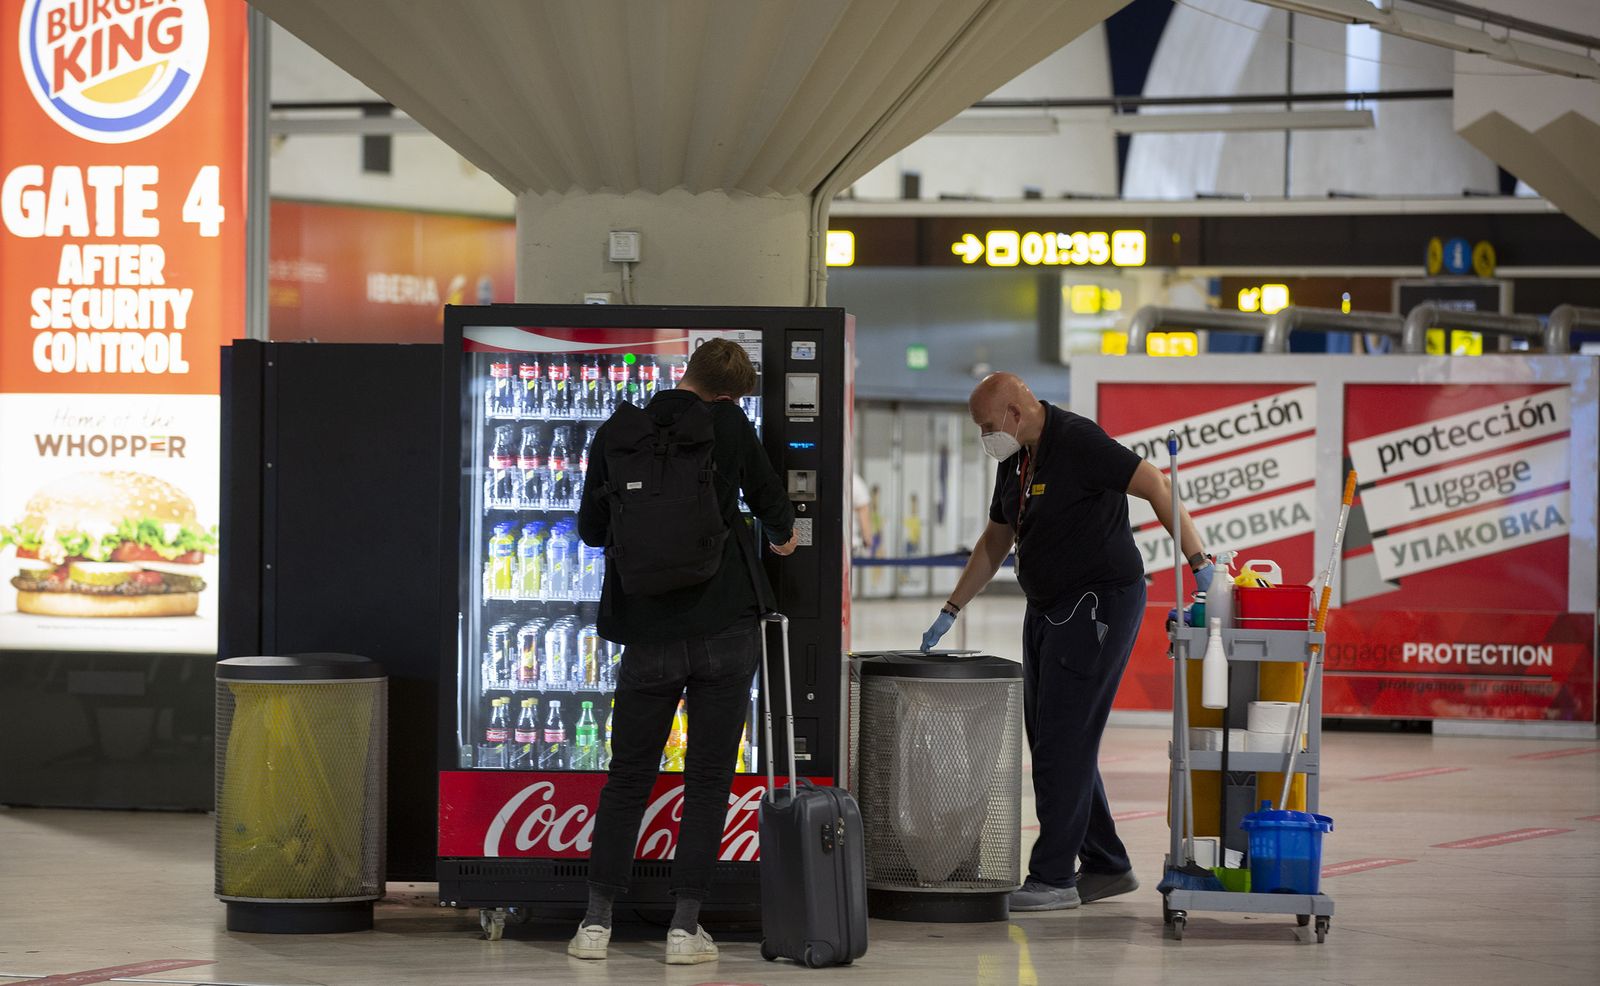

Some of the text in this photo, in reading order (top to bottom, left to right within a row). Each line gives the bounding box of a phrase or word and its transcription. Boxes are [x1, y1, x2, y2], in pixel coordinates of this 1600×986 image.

[47, 0, 177, 45] BUR
[53, 7, 183, 94] KING
[1, 165, 225, 238] GATE 4
[57, 244, 166, 286] AFTER
[366, 272, 441, 306] IBERIA
[30, 287, 194, 330] SECURITY
[32, 331, 190, 375] CONTROL
[34, 434, 187, 458] WHOPPER
[1377, 397, 1557, 474] protección
[1178, 457, 1281, 505] uggage
[1405, 459, 1532, 511] luggage
[1143, 501, 1311, 562] УКОВКА
[1389, 504, 1567, 567] УПАКОВКА
